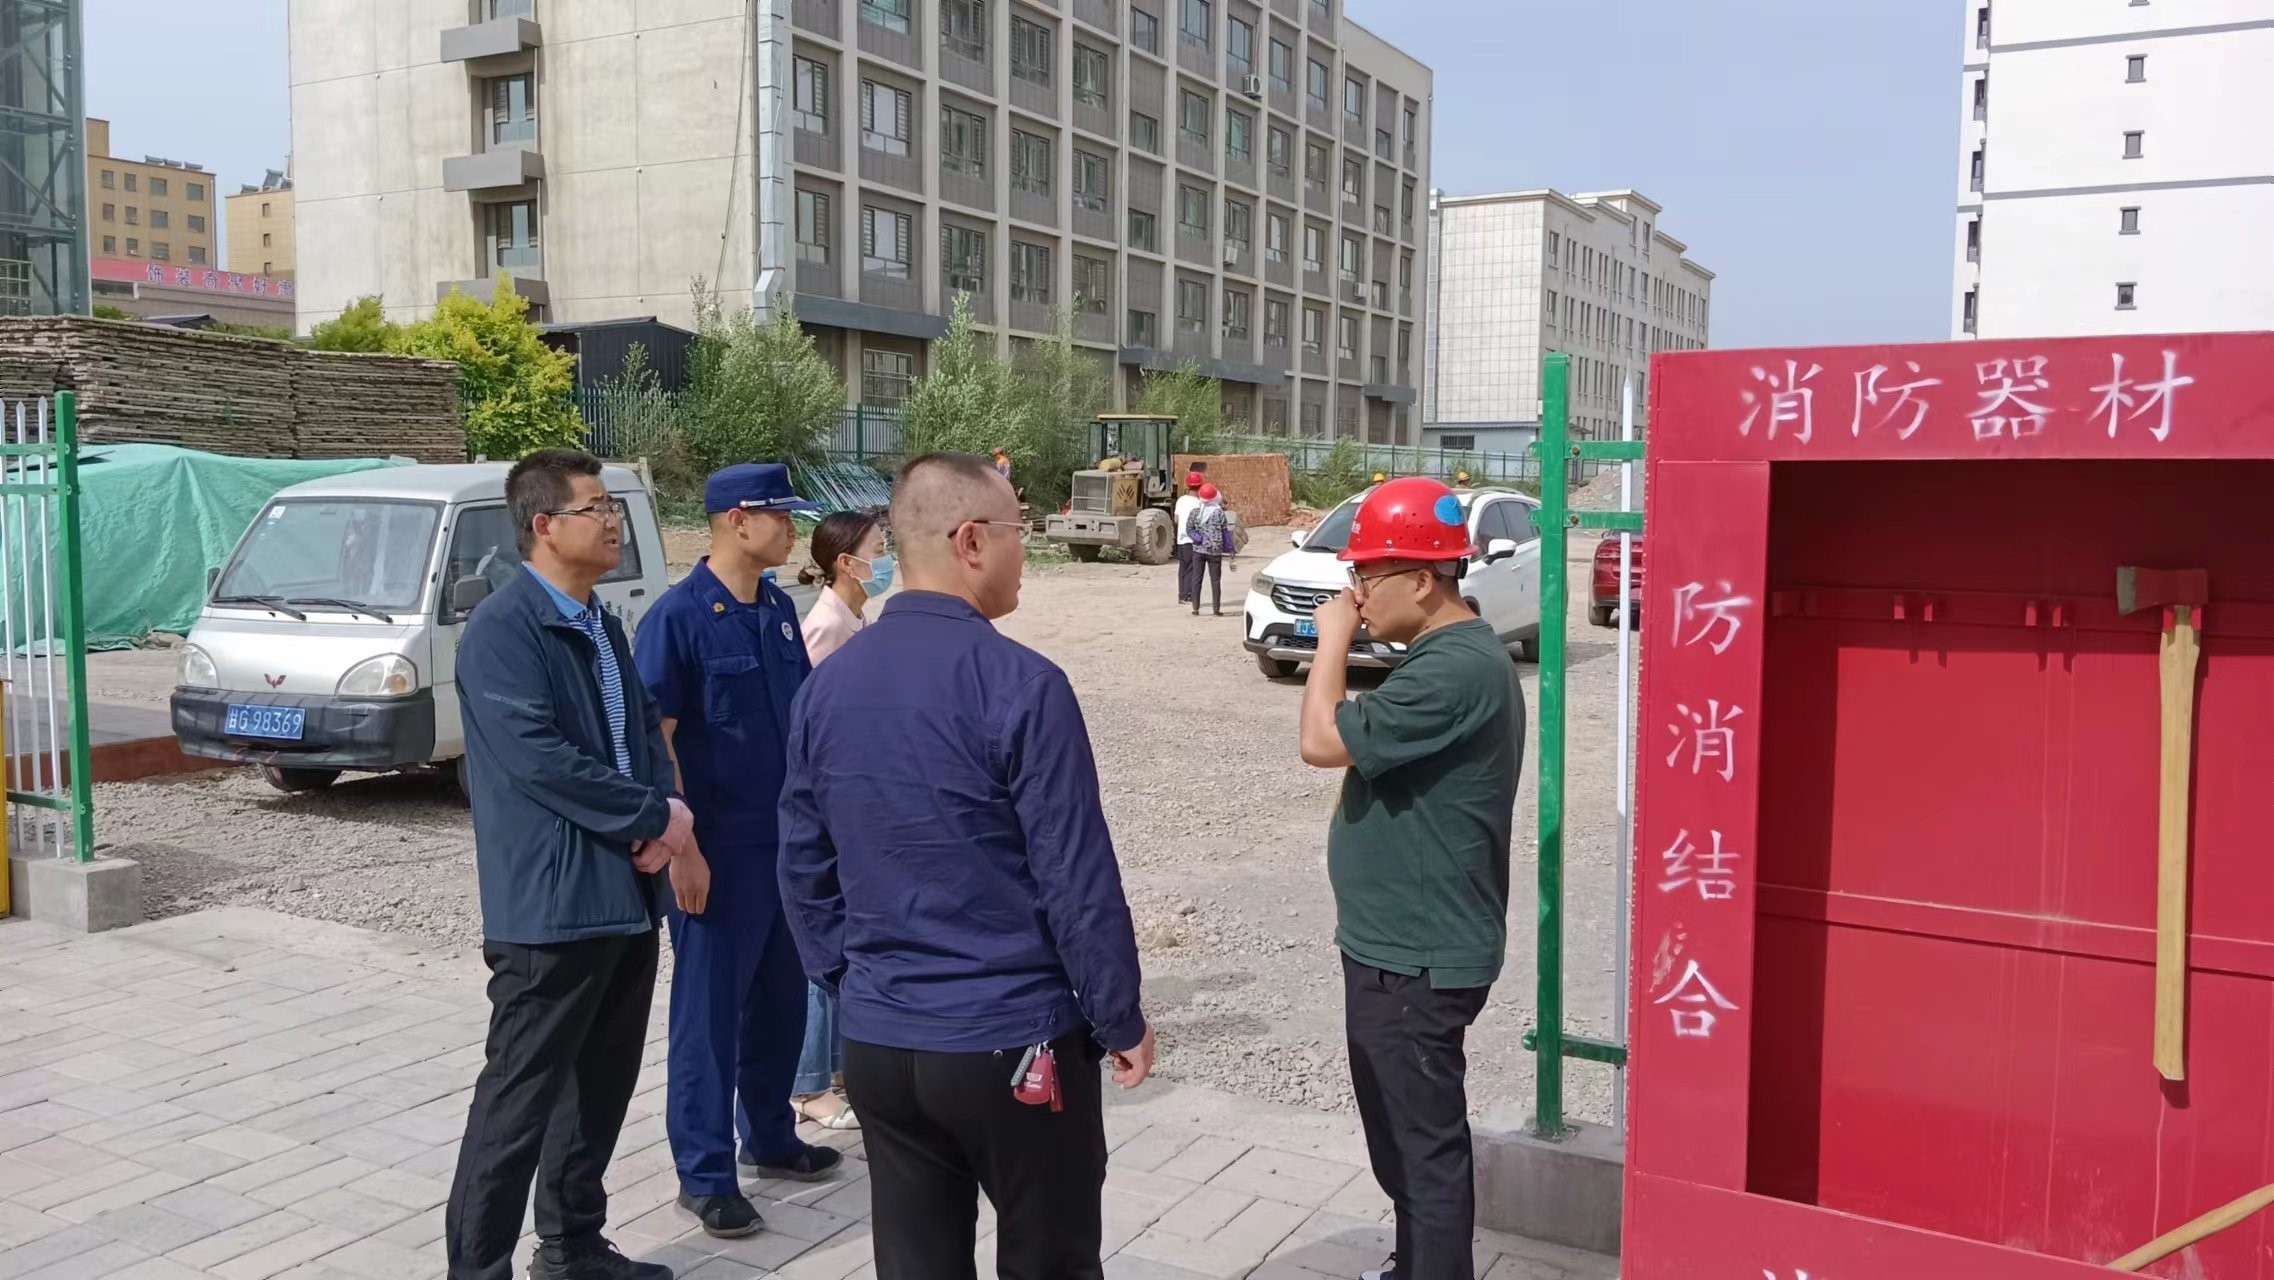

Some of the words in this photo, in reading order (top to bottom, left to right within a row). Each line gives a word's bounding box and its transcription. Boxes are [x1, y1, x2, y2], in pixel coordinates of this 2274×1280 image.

[1738, 350, 2194, 444] 消防器材
[1654, 580, 1754, 1038] 防消结合
